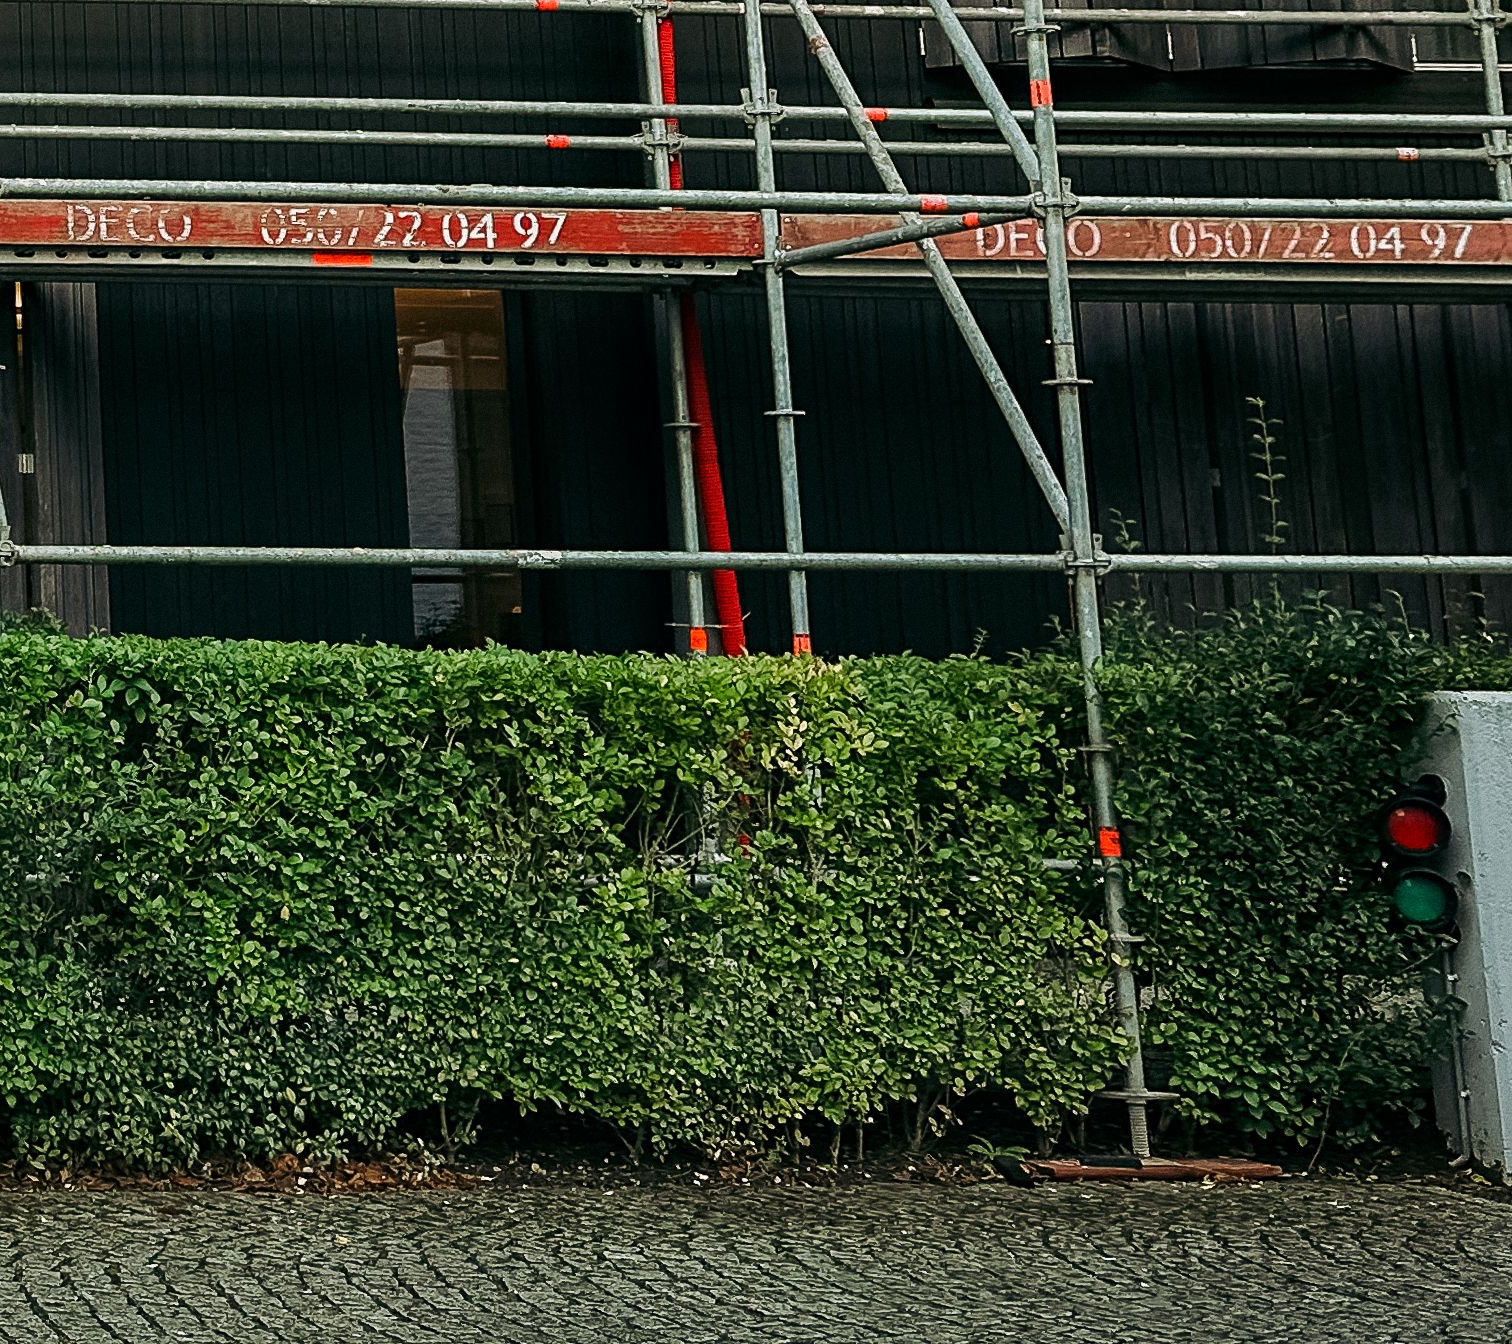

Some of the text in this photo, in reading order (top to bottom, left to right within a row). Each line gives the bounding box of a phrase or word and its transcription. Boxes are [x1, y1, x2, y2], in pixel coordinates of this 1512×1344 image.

[66, 205, 567, 250] DECO 050/22 04 97
[1168, 221, 1336, 260] 050/22
[1350, 221, 1406, 261] 04
[1420, 222, 1473, 261] 97
